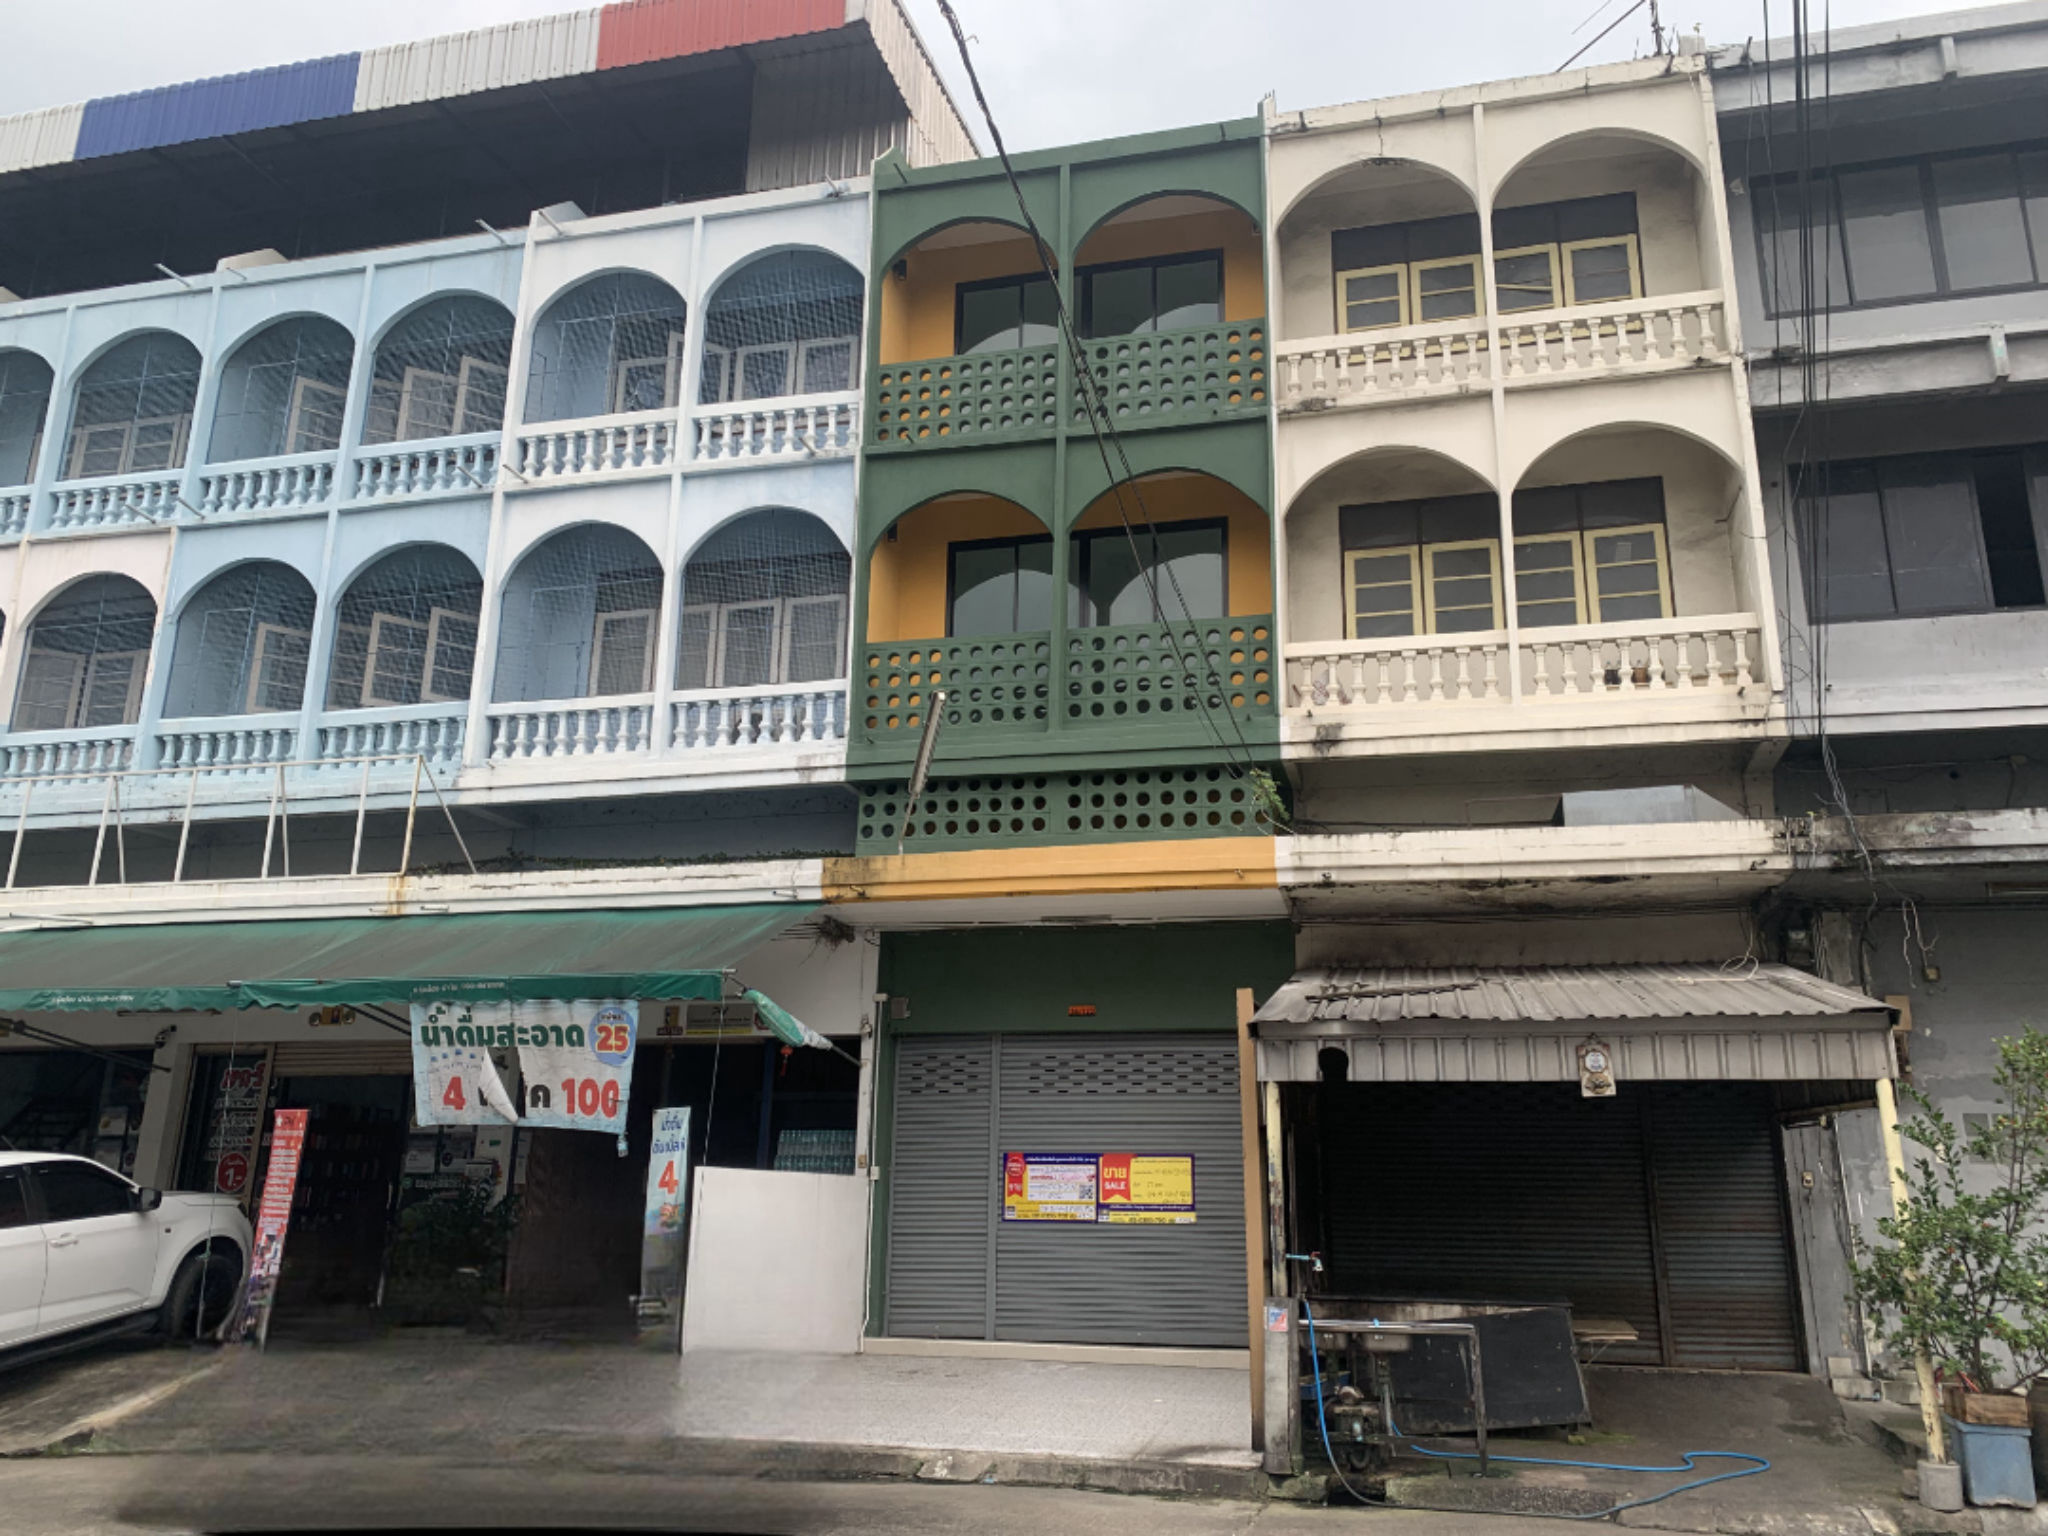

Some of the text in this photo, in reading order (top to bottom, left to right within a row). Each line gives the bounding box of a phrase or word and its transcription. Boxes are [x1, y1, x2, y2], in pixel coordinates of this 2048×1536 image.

[420, 1006, 585, 1047] น้ำดื่มสะอาด
[595, 1024, 629, 1053] 25
[443, 1076, 466, 1111] 4
[561, 1078, 619, 1118] 100
[657, 1160, 679, 1194] 4
[1103, 1167, 1128, 1179] ขาย
[1104, 1181, 1127, 1190] SALE
